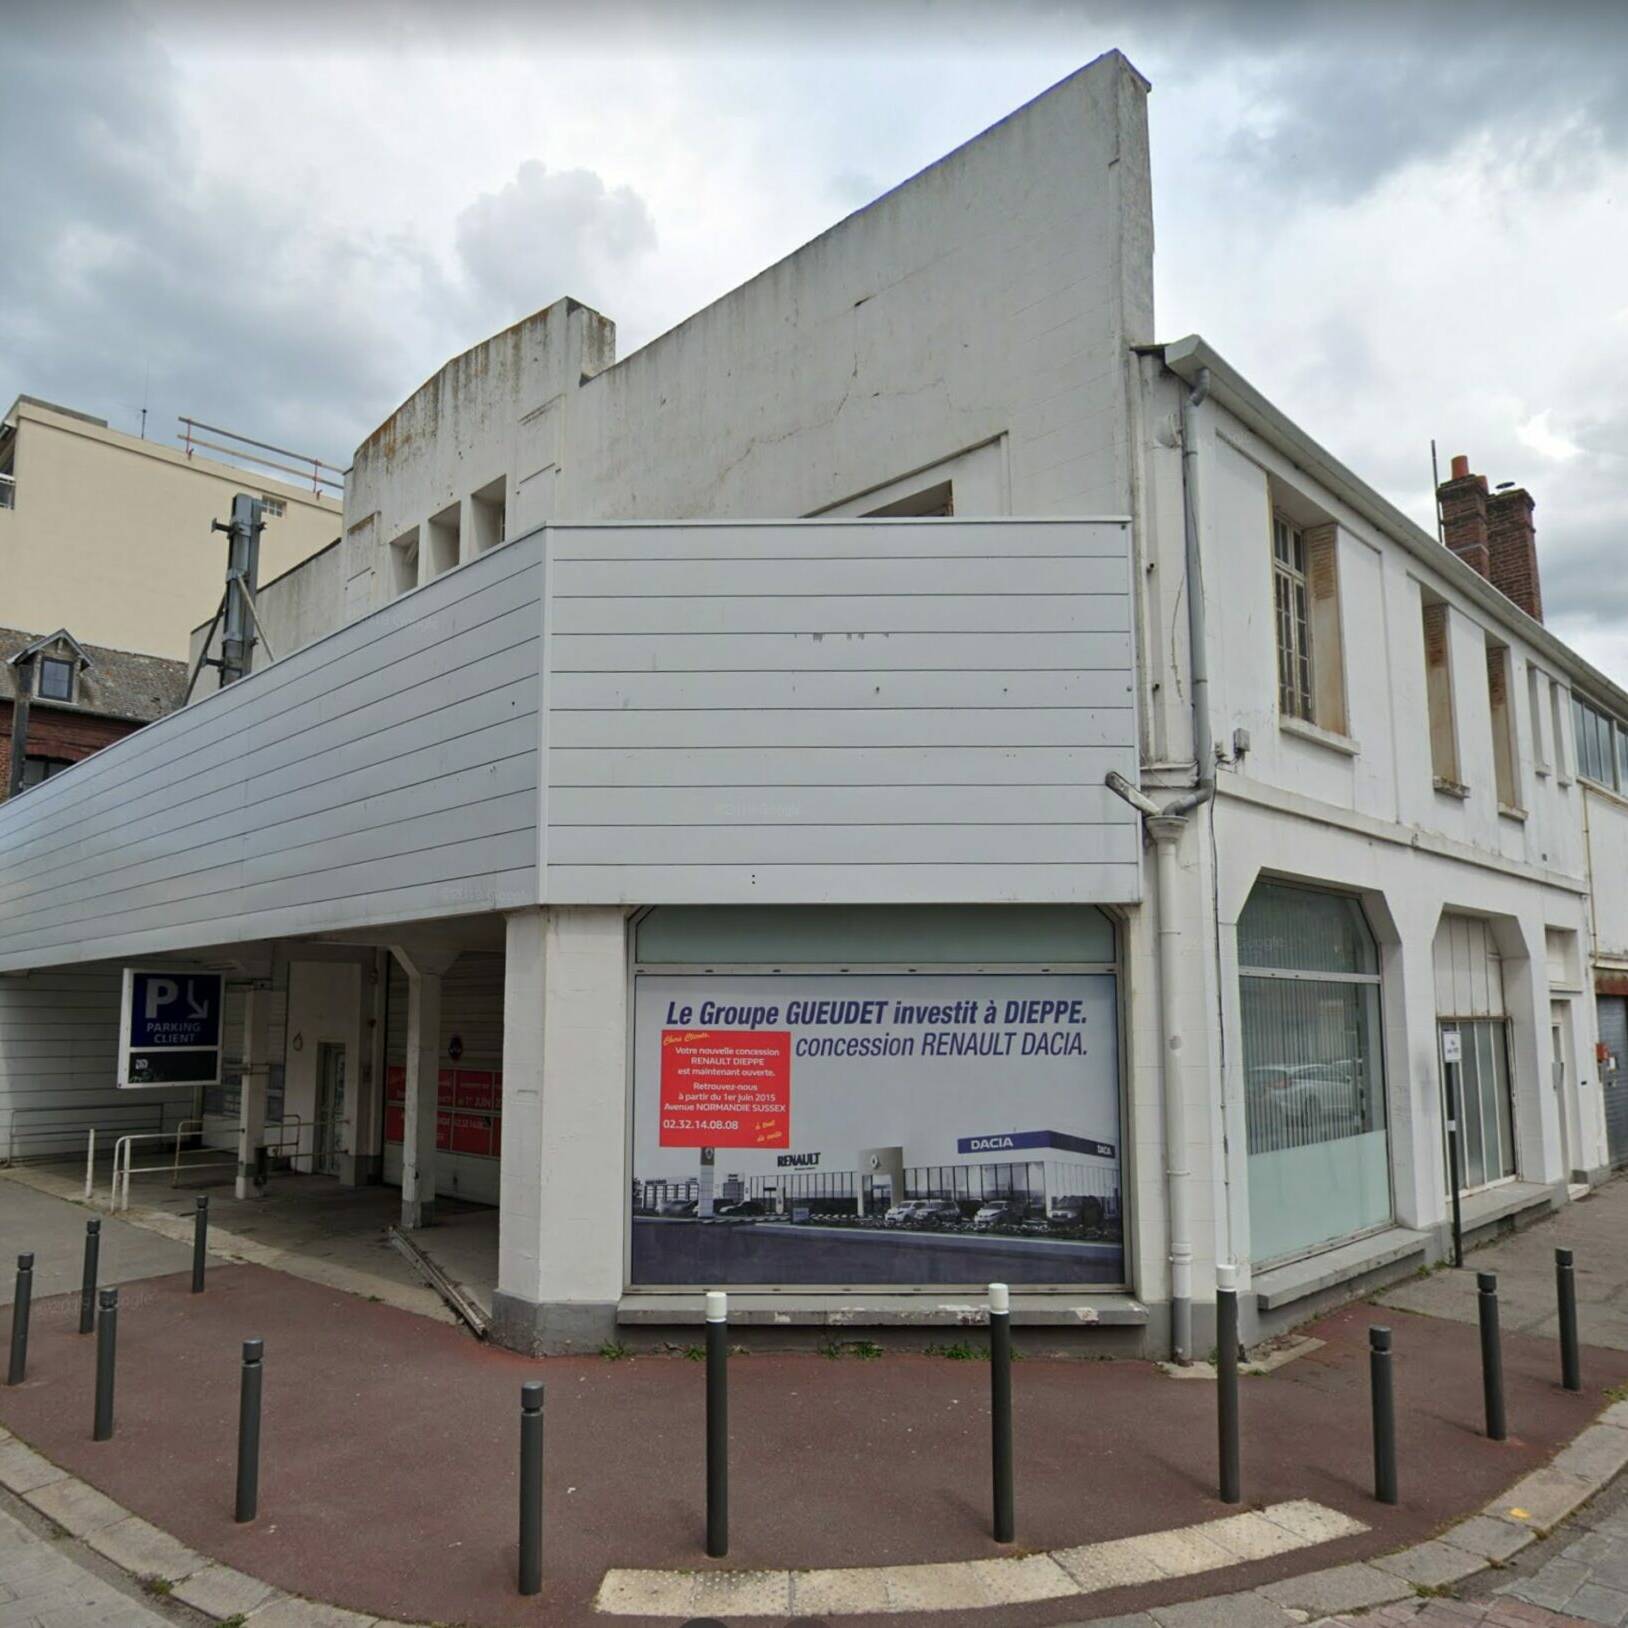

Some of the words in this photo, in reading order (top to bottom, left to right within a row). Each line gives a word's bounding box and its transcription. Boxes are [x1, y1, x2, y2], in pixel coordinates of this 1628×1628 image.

[145, 978, 178, 1019] P
[666, 1001, 692, 1025] Le
[700, 1001, 779, 1029] Groupe
[786, 1001, 889, 1025] GUEUDET
[893, 1001, 978, 1024] investit
[984, 1001, 997, 1024] à
[1004, 1001, 1087, 1024] DIEPPE.
[146, 1022, 201, 1032] PARKING
[154, 1033, 195, 1043] CLIENT
[795, 1033, 914, 1056] concession
[921, 1032, 1017, 1056] RENAULT
[1021, 1032, 1088, 1056] DACIA.
[676, 1047, 697, 1055] Votre
[699, 1047, 733, 1055] nouvelle
[735, 1048, 780, 1056] concession
[691, 1057, 730, 1065] RENAULT
[733, 1058, 765, 1066] DIEPPE
[692, 1068, 740, 1076] maintenant
[741, 1069, 776, 1077] ouverte.
[693, 1082, 758, 1091] Retrouvez-nous
[678, 1092, 684, 1100] à
[685, 1093, 709, 1102] partir
[710, 1093, 721, 1101] du
[739, 1094, 754, 1103] juin
[755, 1094, 776, 1102] 2015
[696, 1104, 749, 1112] NORMANDIE
[752, 1104, 786, 1112] SUSSEX
[663, 1120, 739, 1130] 02.32.14.08.08
[969, 1137, 1014, 1150] DACIA
[777, 1152, 821, 1168] RENAULT
